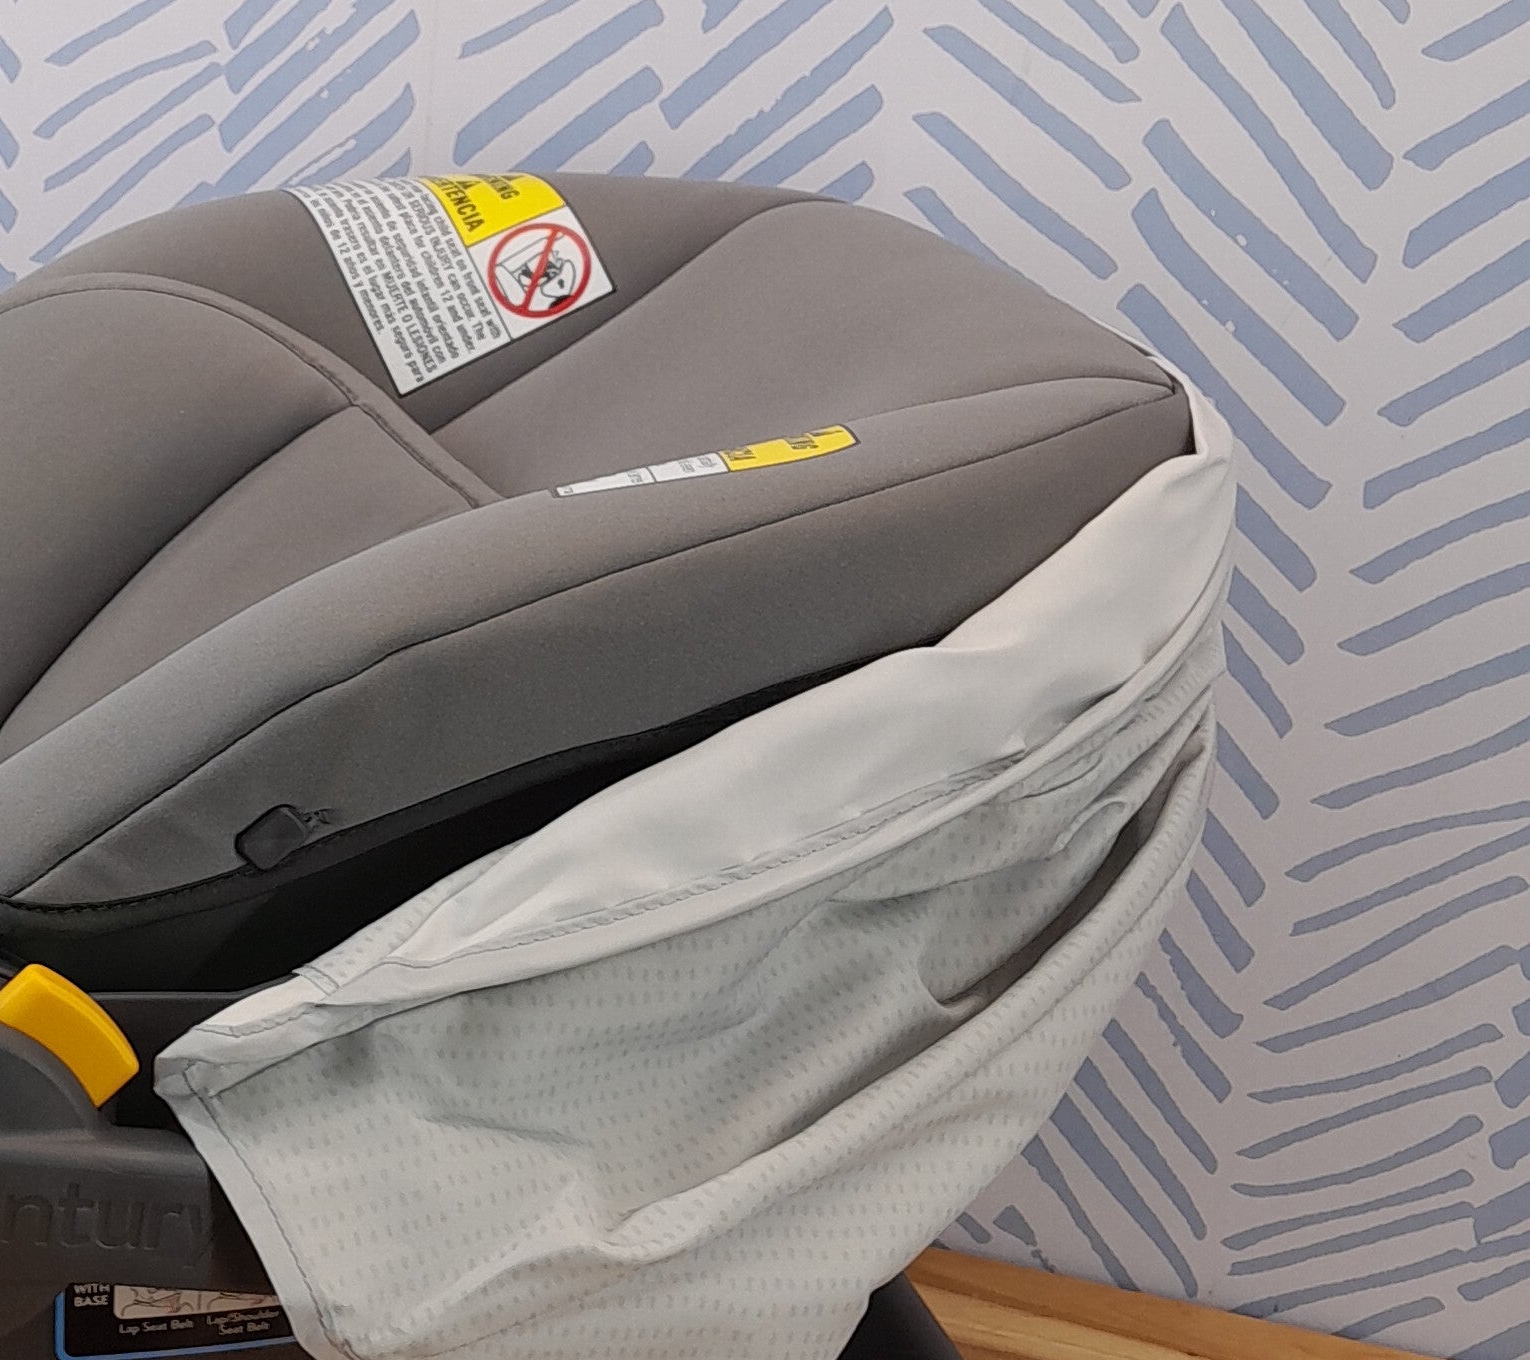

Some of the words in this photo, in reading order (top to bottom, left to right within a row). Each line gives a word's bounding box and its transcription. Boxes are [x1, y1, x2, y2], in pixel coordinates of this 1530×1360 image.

[336, 241, 351, 255] 12
[381, 270, 408, 313] MUERTE
[429, 235, 454, 270] INJURY
[446, 272, 461, 291] can
[471, 320, 485, 341] The
[439, 289, 454, 303] 12
[431, 344, 446, 364] con
[73, 1282, 110, 1294] WITH
[73, 1294, 108, 1307] BASE
[118, 1323, 140, 1335] Lap
[141, 1320, 167, 1332] Seat
[169, 1318, 194, 1330] Belt
